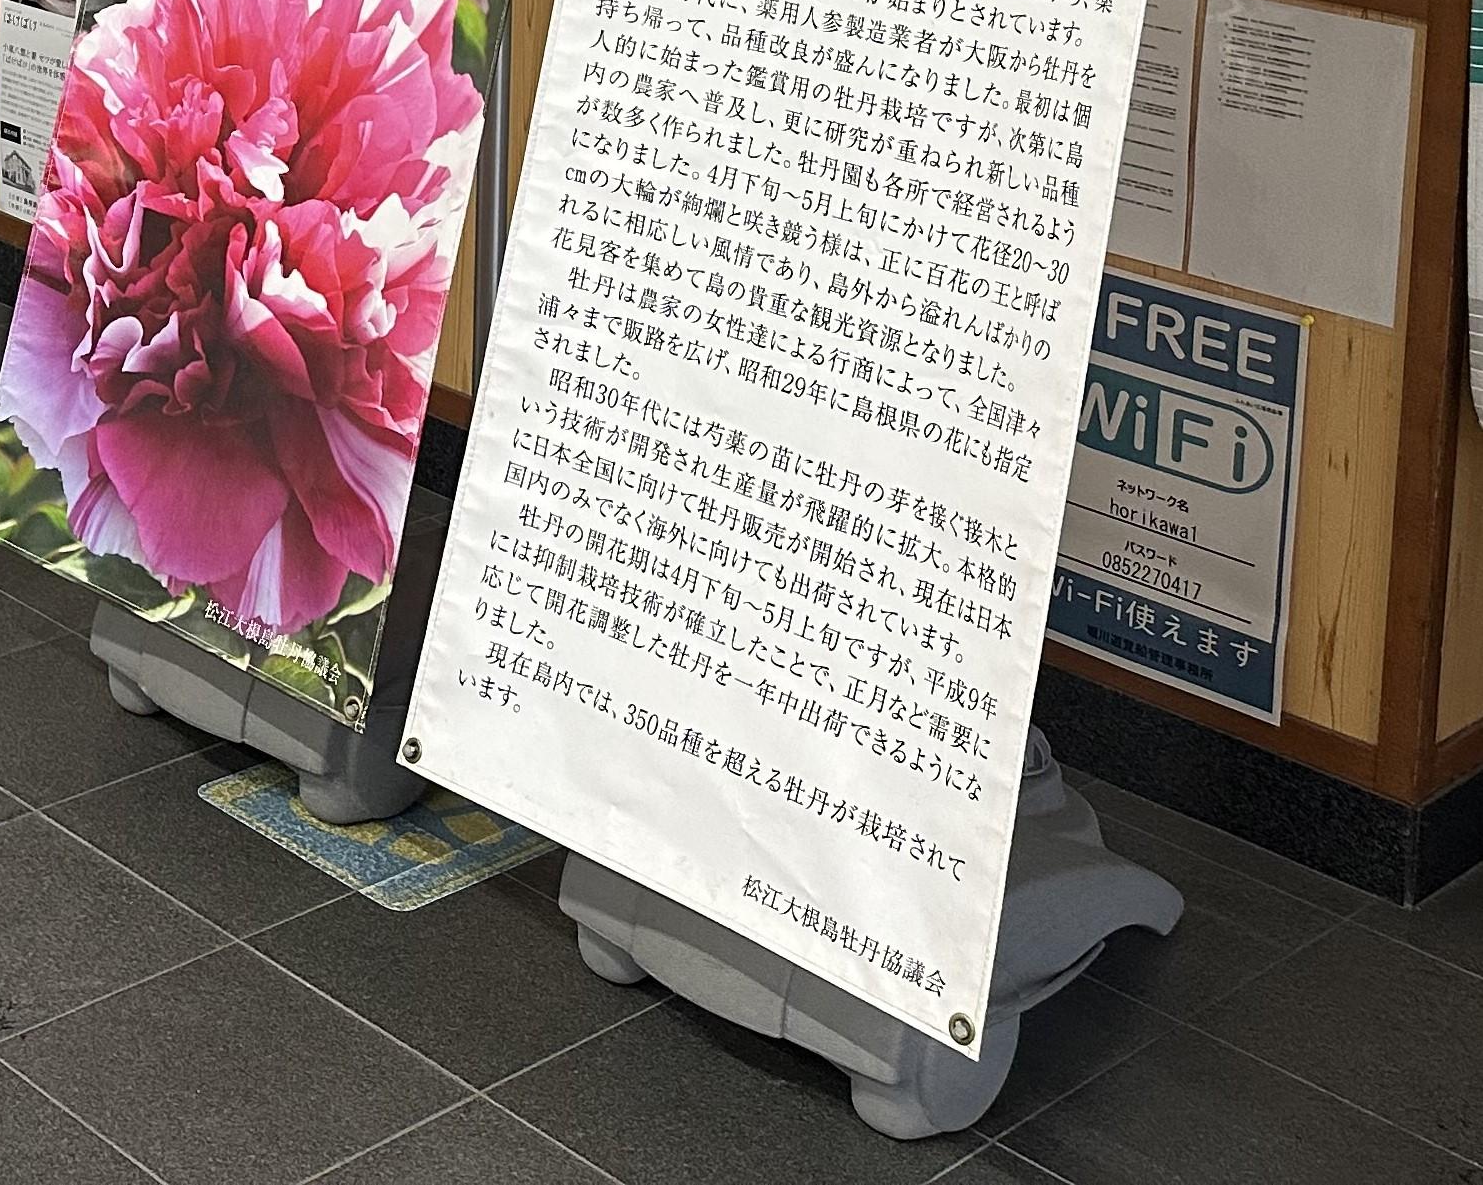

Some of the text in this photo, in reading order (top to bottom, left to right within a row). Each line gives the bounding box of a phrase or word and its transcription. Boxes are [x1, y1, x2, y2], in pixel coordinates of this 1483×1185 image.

[576, 93, 1078, 251] が数多く作られました。牡丹園も各所で経営されるよう
[583, 60, 1082, 209] 内の農家へ普及し、更に研究が重ねられ新しい品種
[591, 27, 1084, 170] 人的に始まった鑑賞用の牡丹栽培ですが、次第に島
[559, 192, 1052, 361] れるに相応しい風情であり、島外から溢れんばかりの
[565, 162, 1061, 323] cmの大輪が絢爛と咲き競う様は、正に百花の王と呼ば
[570, 125, 1071, 286] になりました。4月下旬～5月上旬にかけて花径20～30
[533, 324, 642, 384] されました。
[538, 291, 1032, 485] 浦々まで販路を広げ、昭和29年に島根県の花にも指定
[550, 225, 1018, 394] 花見客を集めて島の貴重な観光資源となりました。
[567, 264, 1042, 440] 牡丹は農家の女性達による行商によって、全国津々
[1107, 291, 1277, 386] FREE
[513, 427, 1014, 641] に日本全国に向けて牡丹販売が開始され、現在は日本
[521, 396, 1018, 603] いう技術が開発され生産量が飛躍的に拡大。本格的
[548, 366, 1019, 562] 昭和30年代には芍薬の苗に牡丹の芽を接ぐ接木と
[1117, 480, 1189, 513] ネットワーク名
[474, 596, 556, 652] りました。
[503, 459, 965, 665] 国内のみでなく海外に向けても出荷されています。
[519, 503, 1000, 721] 牡丹の開花期は4月下旬～5月上旬ですが、平成9年
[1102, 551, 1202, 600] 0852270417
[1124, 540, 1178, 566] パスワード
[458, 667, 522, 715] います。
[480, 562, 985, 803] 応じて開花調整した牡丹を一年中出荷できるようにな
[490, 527, 992, 763] には抑制栽培技術が確立したことで、正月など需要に
[486, 640, 967, 883] 現在島内では、350品種を超える牡丹が栽培されて
[741, 874, 948, 998] 松江大根島牡丹協議会
